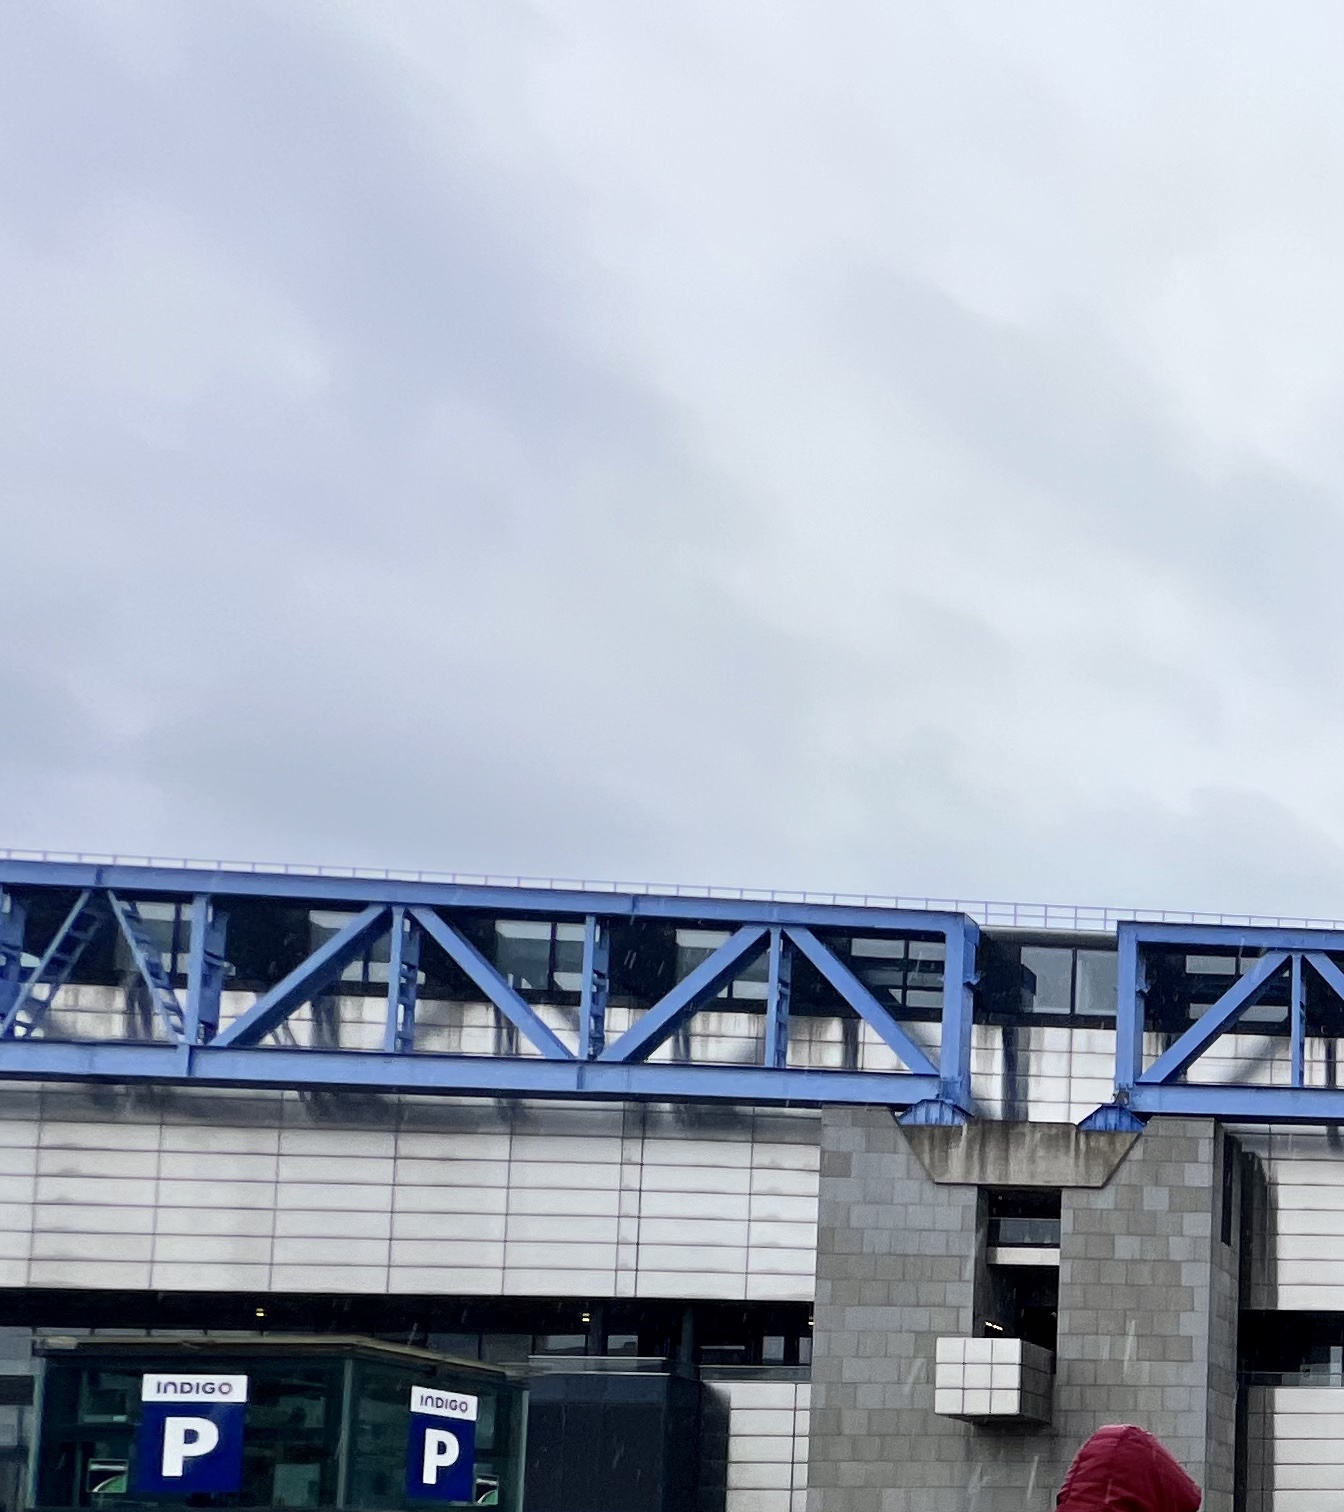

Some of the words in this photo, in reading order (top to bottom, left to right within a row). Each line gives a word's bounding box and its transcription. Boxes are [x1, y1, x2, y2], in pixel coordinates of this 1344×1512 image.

[157, 1381, 233, 1395] INDIGO
[420, 1394, 468, 1414] INDIGO
[162, 1416, 219, 1476] P
[423, 1428, 460, 1485] P
